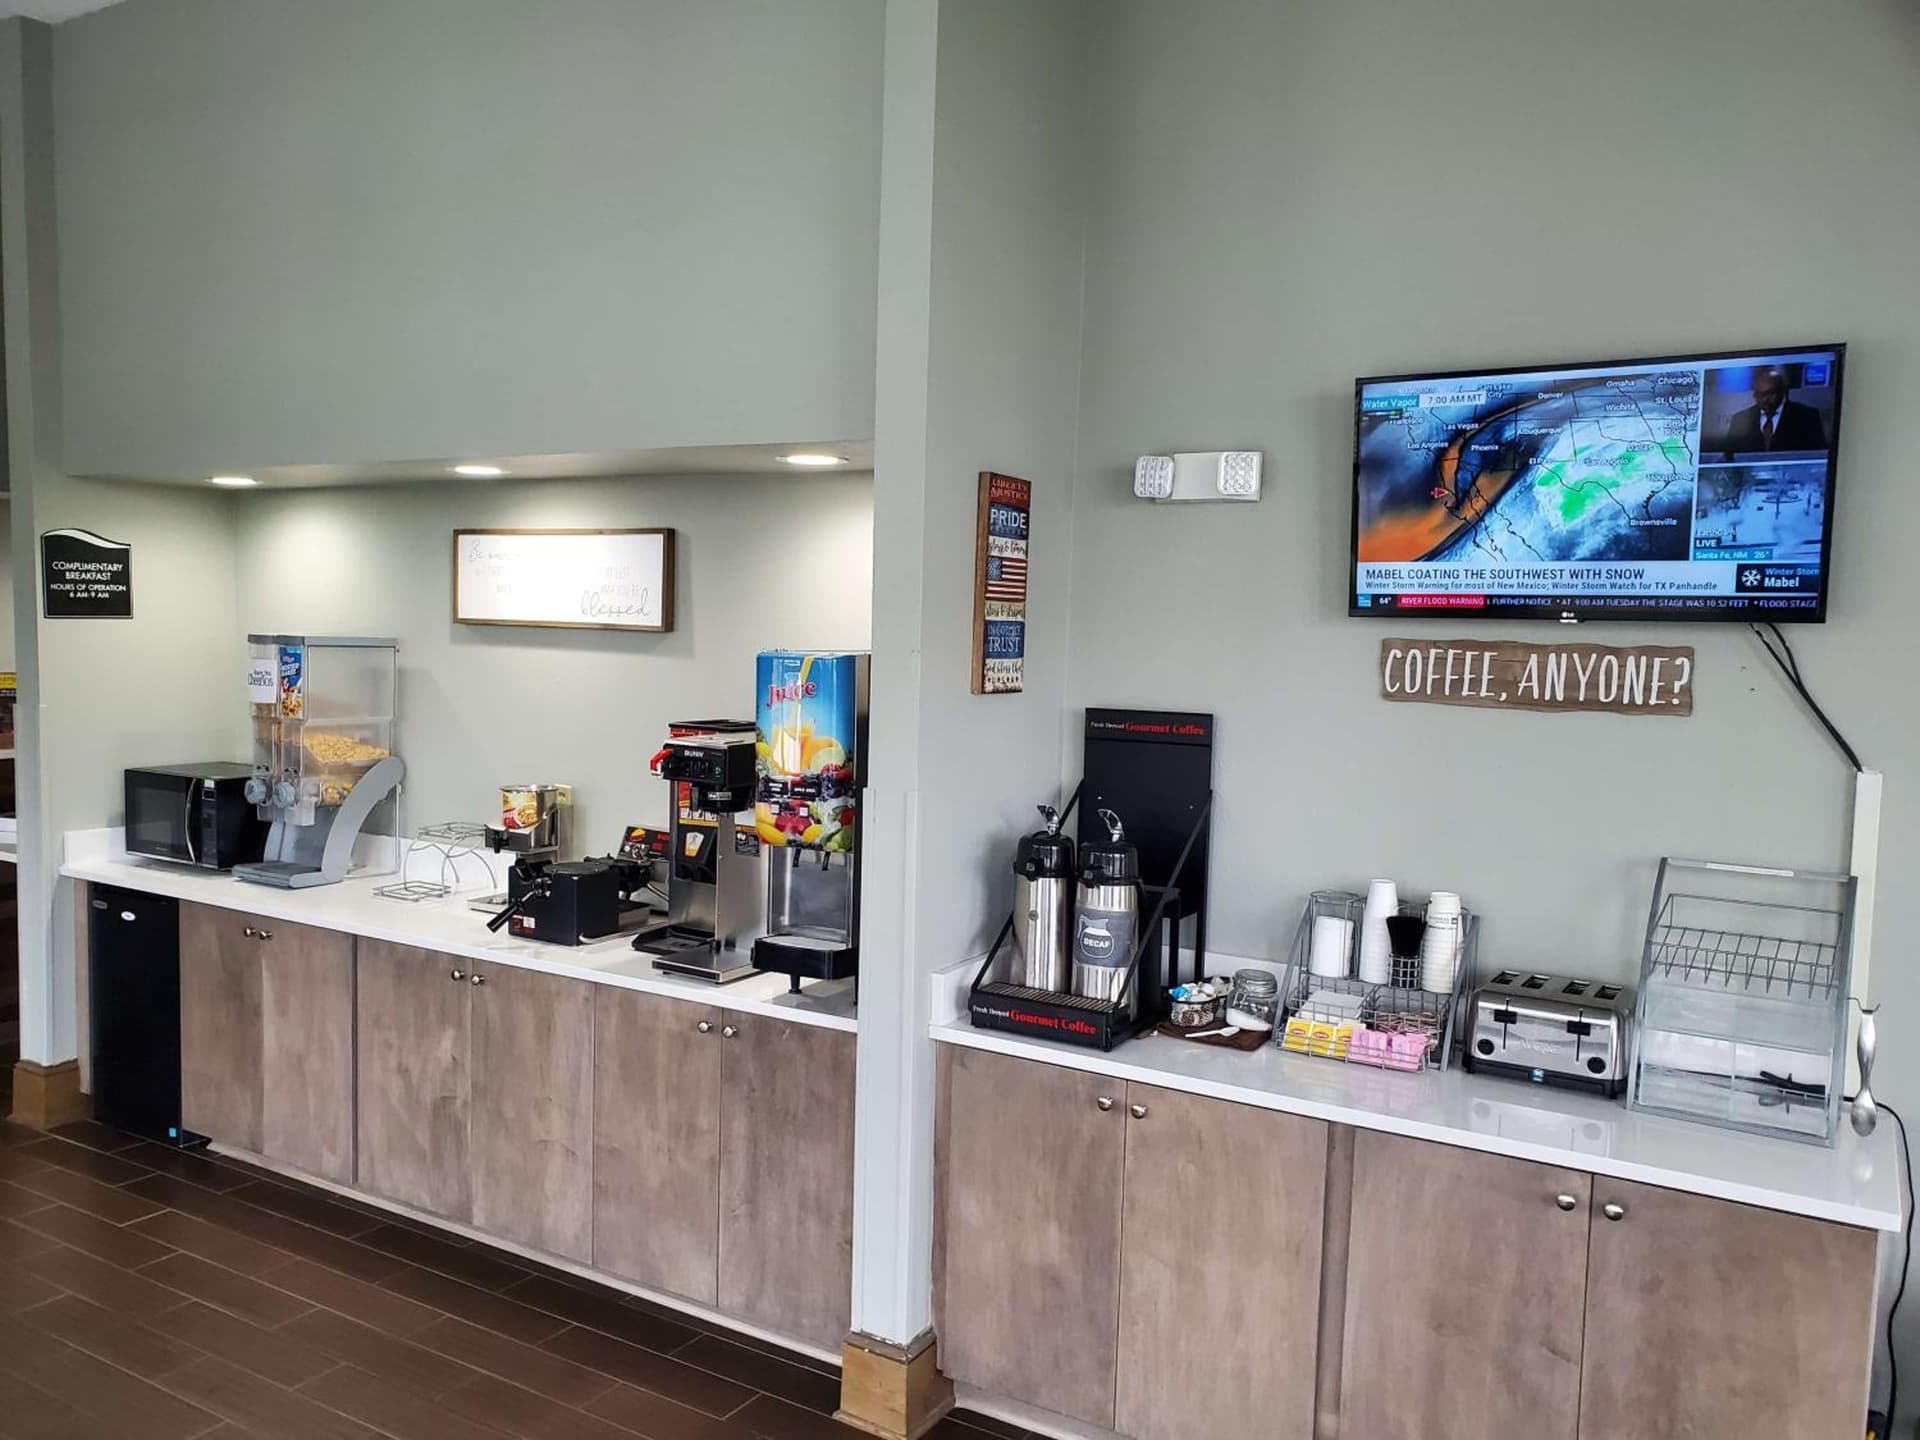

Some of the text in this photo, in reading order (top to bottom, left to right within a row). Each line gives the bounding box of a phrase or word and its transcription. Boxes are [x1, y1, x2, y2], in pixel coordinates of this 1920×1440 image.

[1606, 380, 1635, 388] Omaha
[1658, 376, 1693, 386] Chicago
[1449, 394, 1467, 403] AM
[1467, 393, 1483, 402] MT
[1363, 398, 1418, 409] Water Vapor
[1457, 423, 1479, 431] Vegas
[1421, 441, 1449, 450] Angeles
[990, 508, 1028, 529] PRIDE
[1630, 518, 1678, 527] Brownsville
[1696, 539, 1717, 548] LIVE
[1695, 551, 1718, 559] Santa
[52, 561, 124, 572] COMPLIMENTARY
[65, 571, 112, 580] BREAKFAST
[1365, 568, 1645, 580] MABEL COATING THE SOUTHWEST WITH SNOW
[1764, 568, 1793, 576] Winter
[1365, 581, 1390, 589] Winter
[1392, 581, 1415, 589] Storm
[1417, 581, 1449, 591] Warning
[1451, 581, 1463, 589] for
[1464, 582, 1484, 590] most
[1487, 581, 1496, 590] of
[1499, 582, 1515, 590] New
[1552, 582, 1579, 590] Winter
[1581, 582, 1607, 590] Storm
[1609, 582, 1637, 590] Watch
[1639, 582, 1651, 590] for
[1654, 582, 1666, 590] TX
[1669, 582, 1718, 591] Panhandle
[1764, 576, 1800, 588] Mabel
[50, 583, 127, 592] HOURS OF OPERATION
[580, 588, 651, 618] blessed
[1401, 597, 1423, 605] RIVER
[1424, 597, 1448, 605] FLOOD
[1450, 597, 1485, 606] WARNING
[1606, 599, 1640, 607] TUESDAY
[1729, 600, 1749, 608] FEET
[987, 636, 1021, 653] TRUST
[1384, 648, 1691, 705] COFFEE, ANYONE?
[766, 681, 817, 708] Juice
[1125, 722, 1169, 733] Gourmet
[1172, 724, 1204, 735] Coffee
[1083, 937, 1111, 948] DECAF
[1010, 1010, 1059, 1029] Gourmet
[1061, 1018, 1097, 1035] Coffee
